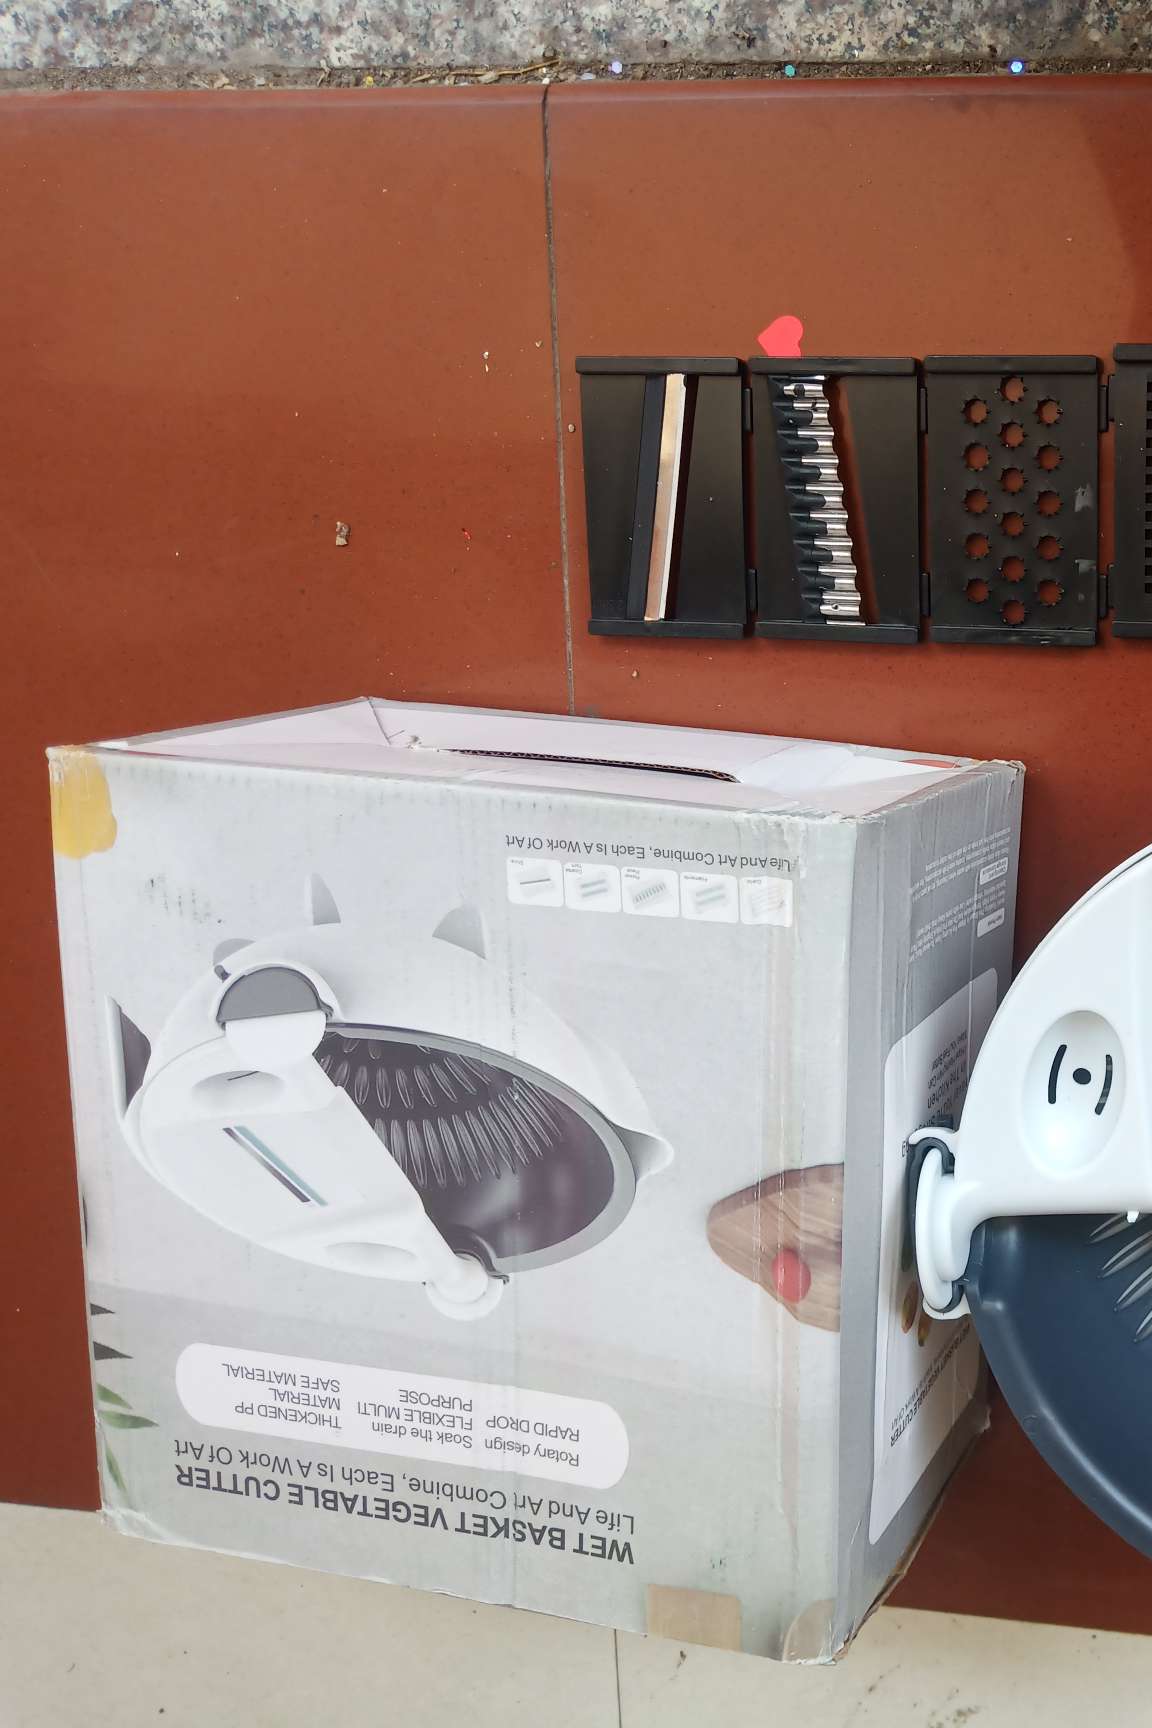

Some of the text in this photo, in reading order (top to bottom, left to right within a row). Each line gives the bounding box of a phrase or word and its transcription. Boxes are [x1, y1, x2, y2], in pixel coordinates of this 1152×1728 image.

[506, 835, 791, 871] Life And Art Combine, Each Is A Work Of Art
[222, 1363, 341, 1393] SAFE MATERIAL
[268, 1388, 341, 1410] MATERIAL
[399, 1389, 473, 1411] PURPOSE
[234, 1402, 342, 1429] THICKENED PP
[357, 1402, 473, 1430] FLEXIBLE MULTI
[486, 1414, 579, 1441] RAPID DROP
[371, 1422, 473, 1448] Soak the drain
[484, 1437, 579, 1466] Rotary design
[174, 1439, 634, 1534] Life And Art Combine, Each Is A Work Of Art
[174, 1464, 634, 1564] WET BASKET VEGETABLE CUTTER
